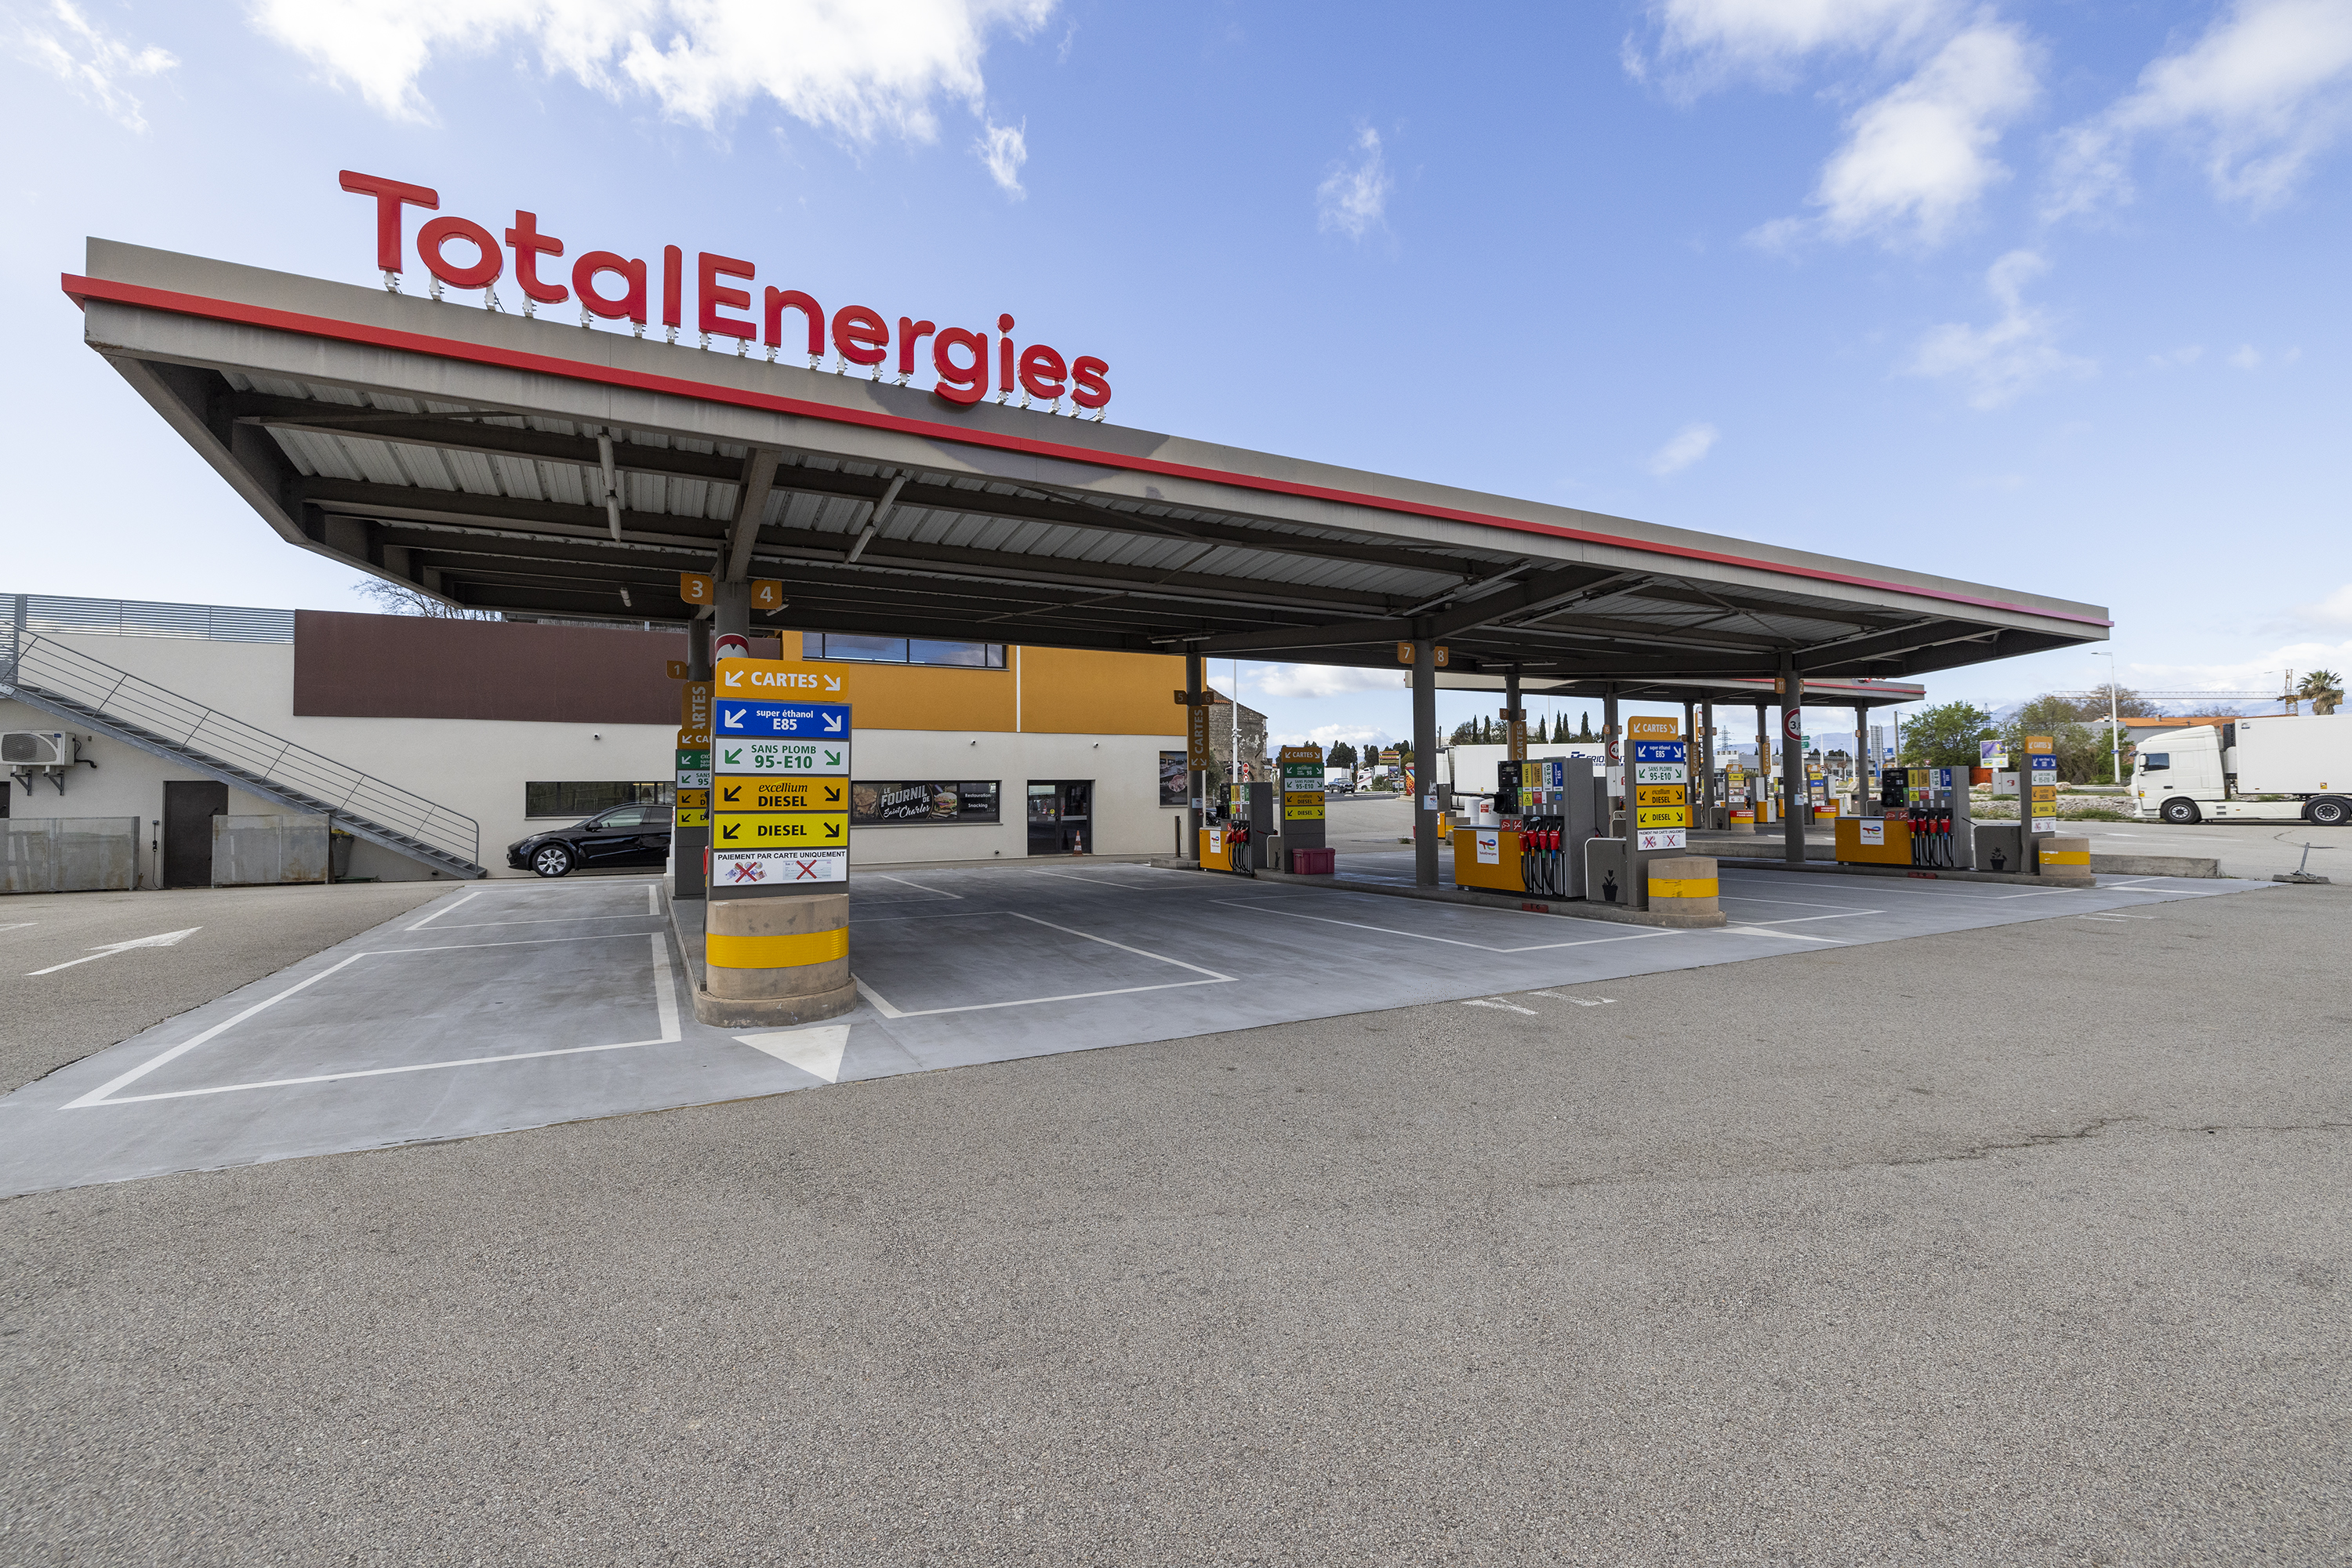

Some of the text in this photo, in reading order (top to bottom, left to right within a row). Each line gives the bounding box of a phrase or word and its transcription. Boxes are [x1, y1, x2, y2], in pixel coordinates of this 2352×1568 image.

[338, 169, 1112, 406] TotalEnergies
[691, 580, 703, 597] 3
[760, 586, 773, 603] 4
[1403, 647, 1410, 659] 7
[1437, 650, 1444, 662] 8
[673, 664, 680, 675] 1
[750, 671, 818, 688] CARTES
[1778, 681, 1784, 690] 11
[1178, 693, 1183, 702] 5
[1205, 694, 1210, 702] 6
[691, 686, 706, 729] ARTES
[756, 709, 814, 718] super éthanol
[772, 718, 797, 731] E85
[1642, 723, 1668, 733] CARTES
[1194, 709, 1203, 754] CARTES
[751, 744, 817, 754] SANS PLOMB
[754, 754, 813, 769] 95-E10
[1650, 772, 1671, 781] 95-E10
[758, 782, 808, 793] excellium
[758, 796, 808, 807] DIESEL
[880, 785, 927, 807] FOURNIL
[883, 803, 931, 818] Saint Charles
[757, 825, 808, 837] DIESEL
